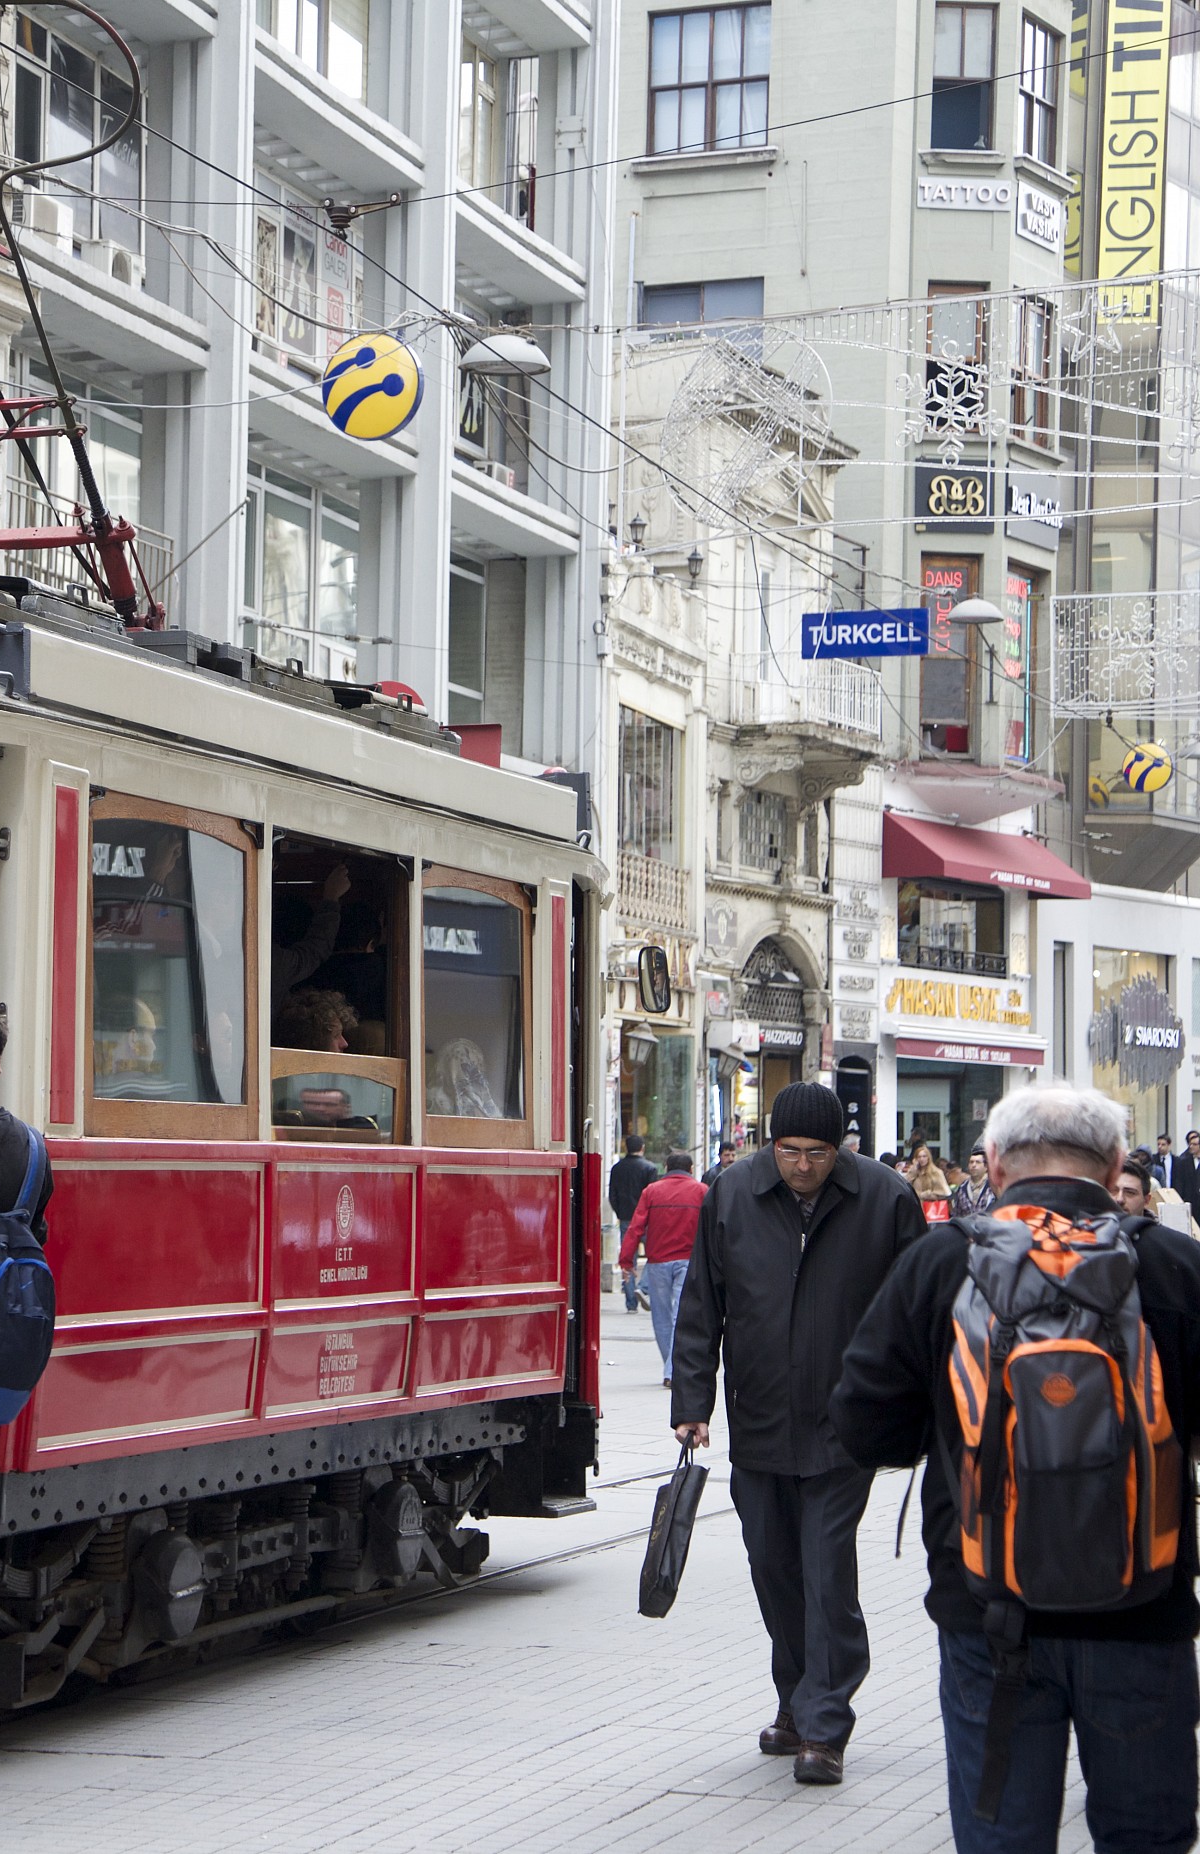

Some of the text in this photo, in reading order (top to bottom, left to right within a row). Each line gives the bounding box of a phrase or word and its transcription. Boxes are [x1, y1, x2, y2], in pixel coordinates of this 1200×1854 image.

[1104, 0, 1163, 318] ENGLISH TI
[919, 182, 1011, 203] TATTOO
[926, 571, 962, 588] DANS
[808, 622, 921, 646] TURKCELL
[902, 978, 958, 1018] HASAN
[958, 984, 1001, 1023] USTA
[765, 1029, 804, 1046] HAZZOPULO
[1136, 1026, 1180, 1048] SWAROVSKI
[320, 1268, 337, 1283] GENEL
